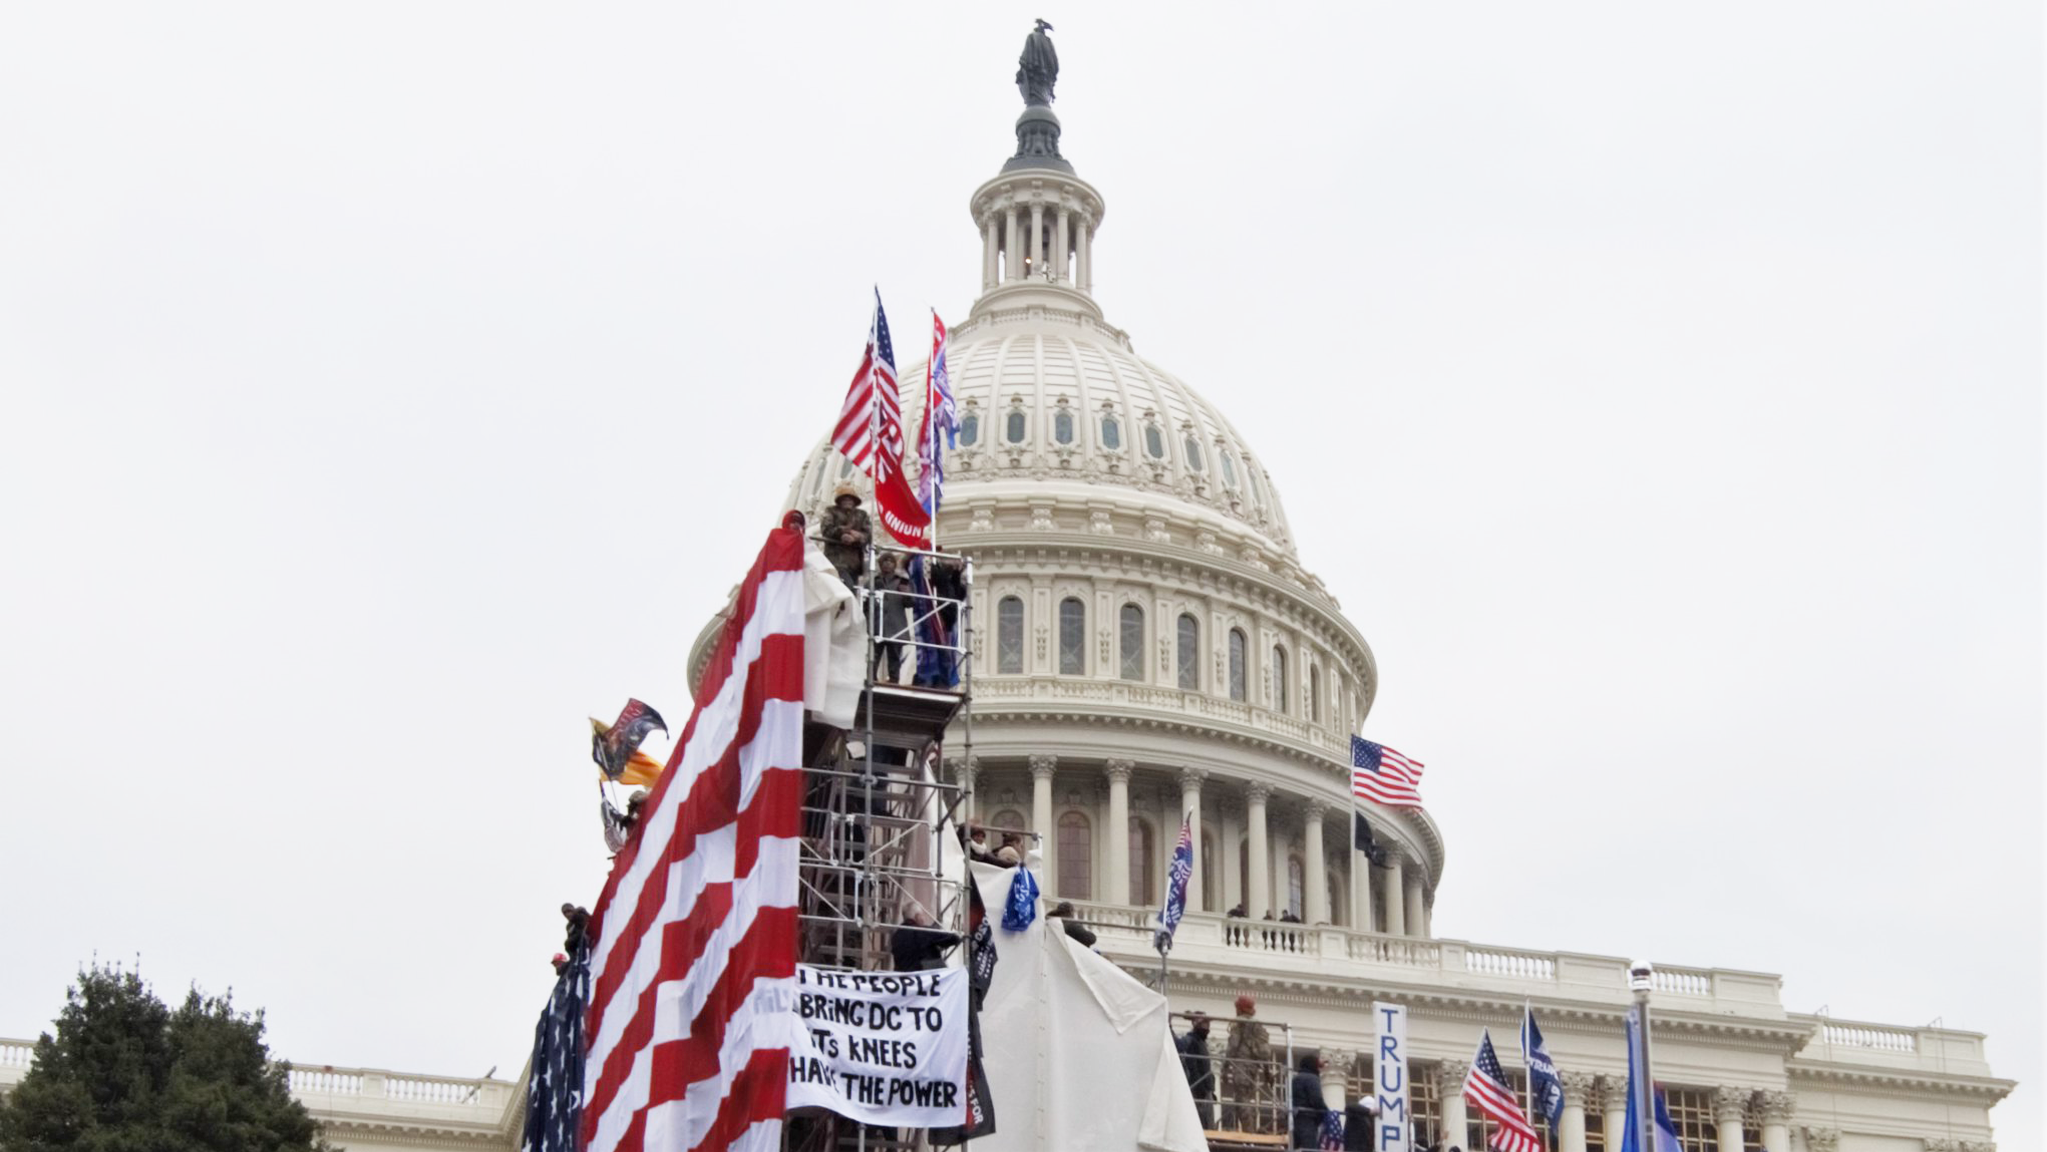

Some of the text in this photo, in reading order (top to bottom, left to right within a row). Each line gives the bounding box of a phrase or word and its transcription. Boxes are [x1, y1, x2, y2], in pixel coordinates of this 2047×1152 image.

[852, 974, 941, 997] PEOPLE
[869, 1002, 903, 1031] DC
[906, 1006, 943, 1033] TO
[840, 1072, 884, 1106] THE
[887, 1077, 958, 1108] POWER
[1379, 1007, 1404, 1152] TRUMP
